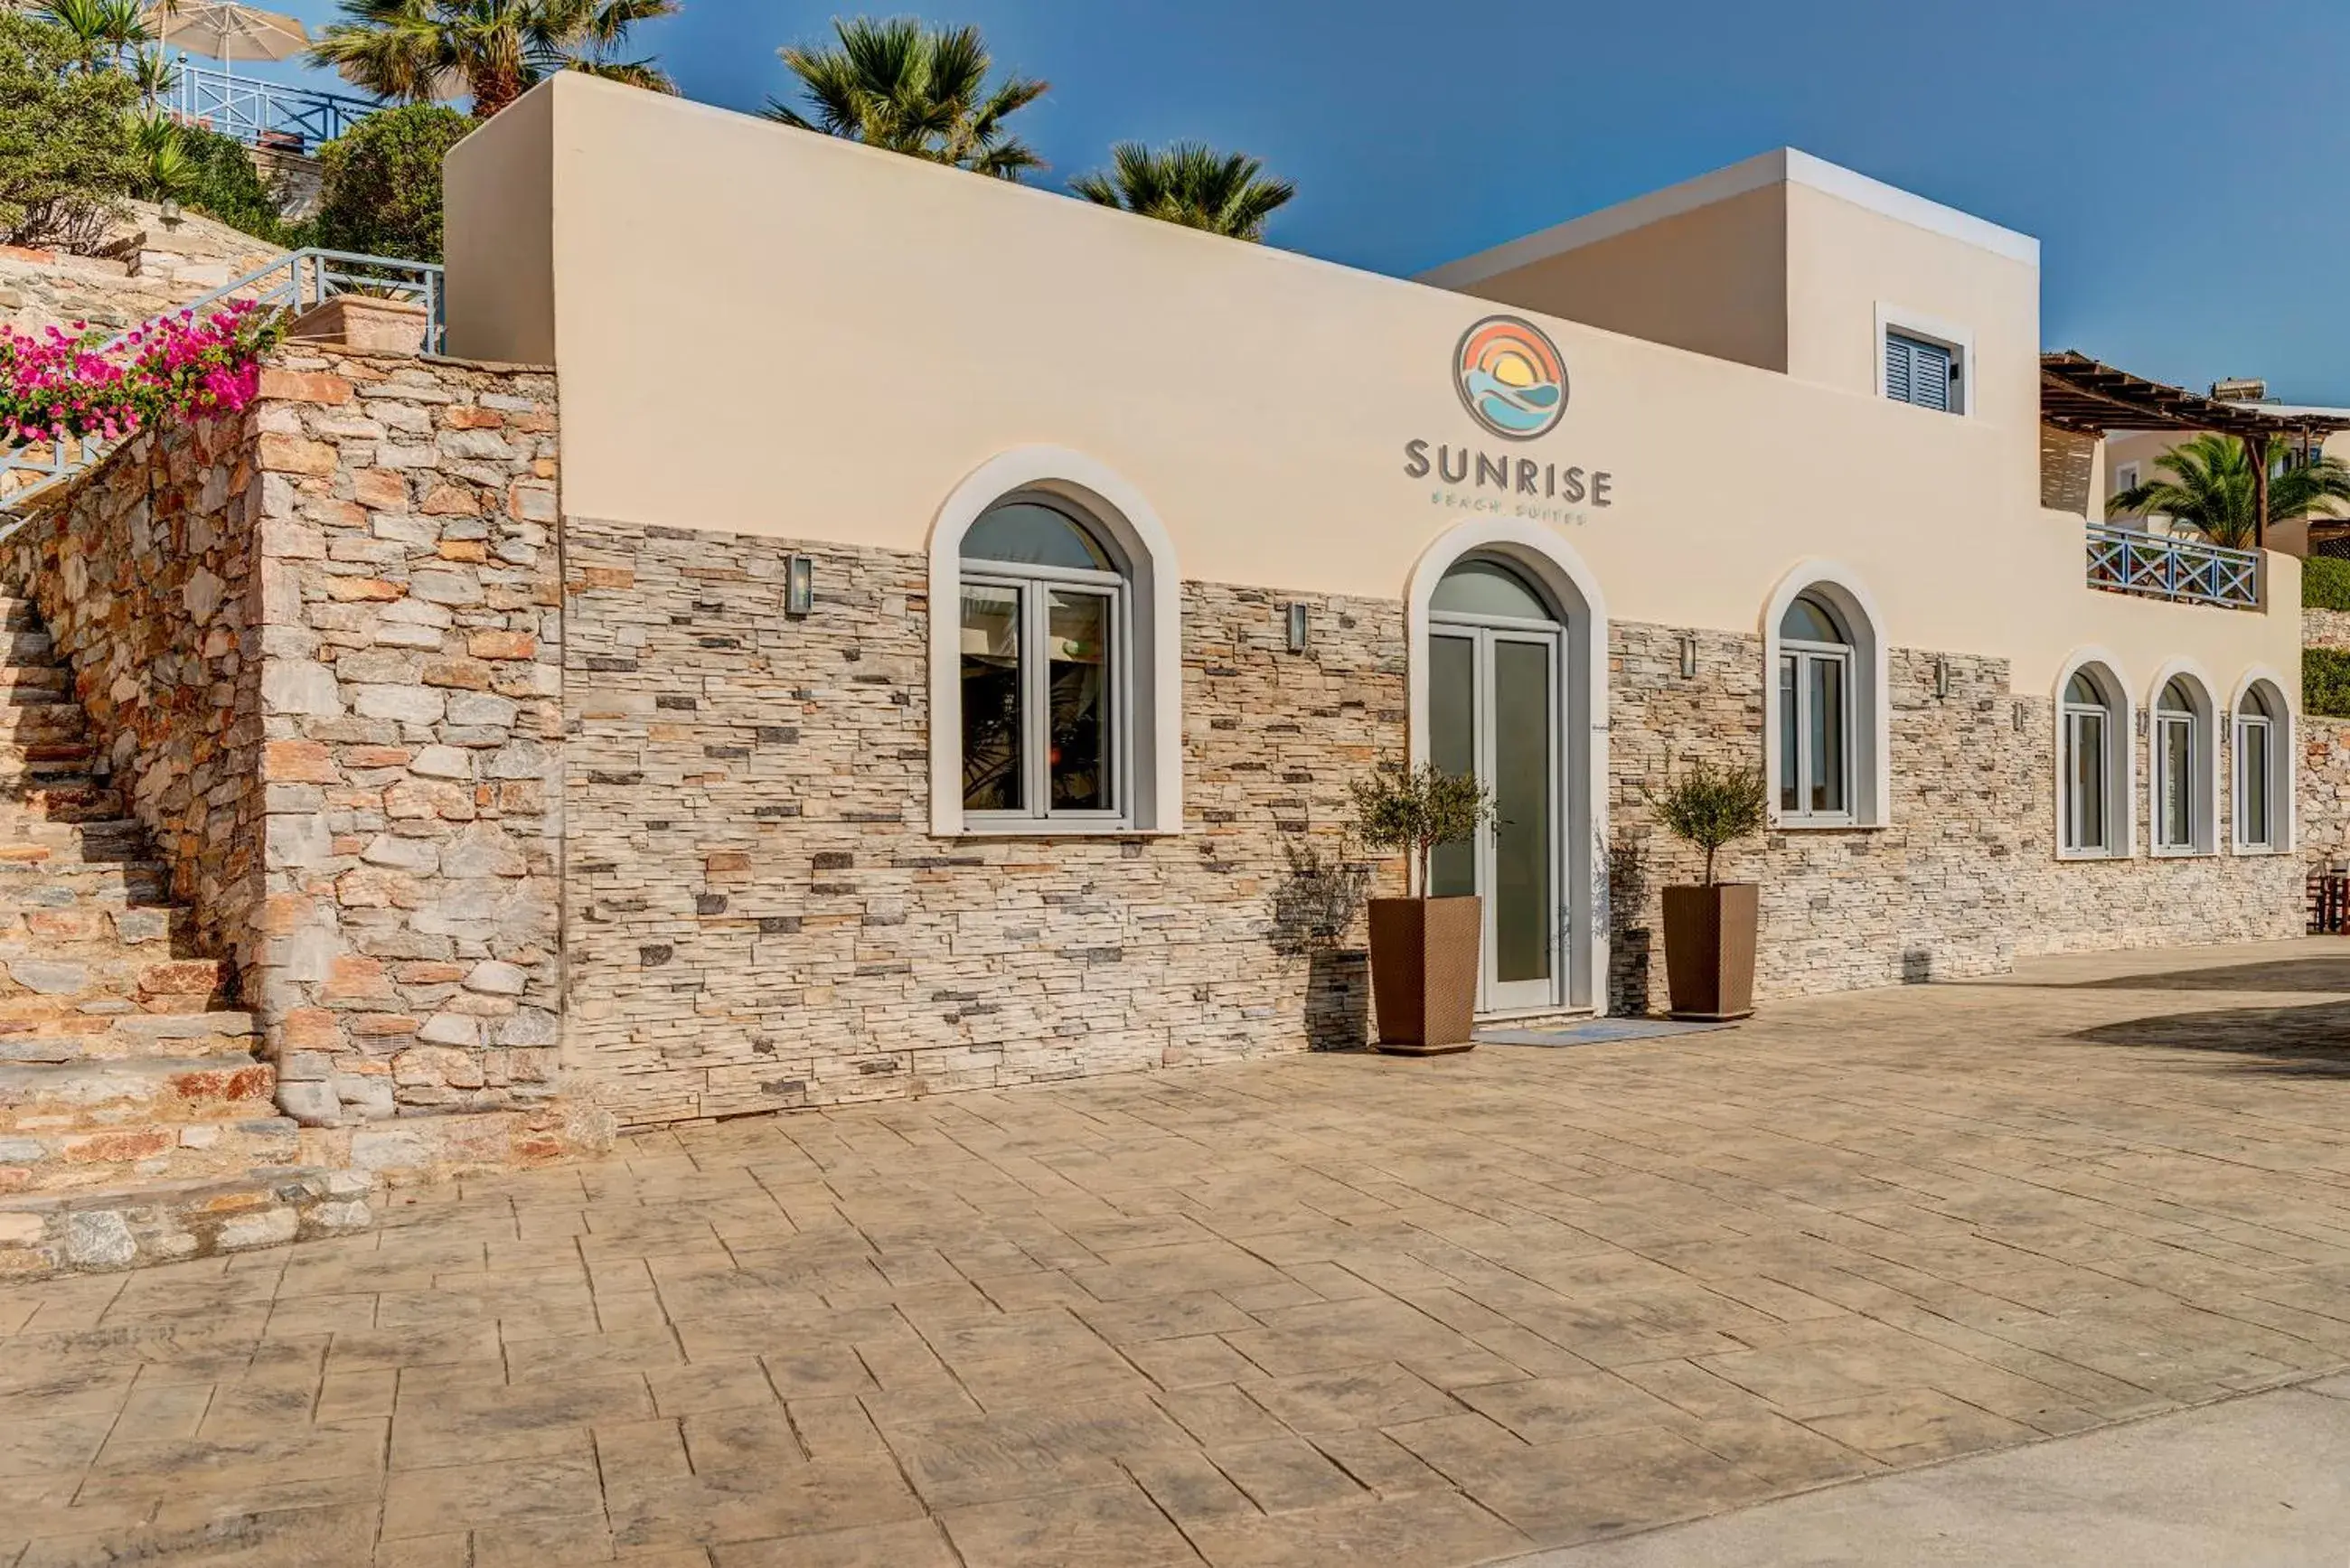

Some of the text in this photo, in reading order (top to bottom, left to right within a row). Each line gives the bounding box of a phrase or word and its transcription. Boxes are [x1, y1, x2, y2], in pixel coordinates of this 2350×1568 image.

[1404, 438, 1612, 507] SUNRISE
[1431, 489, 1587, 526] BEACH SUITES
